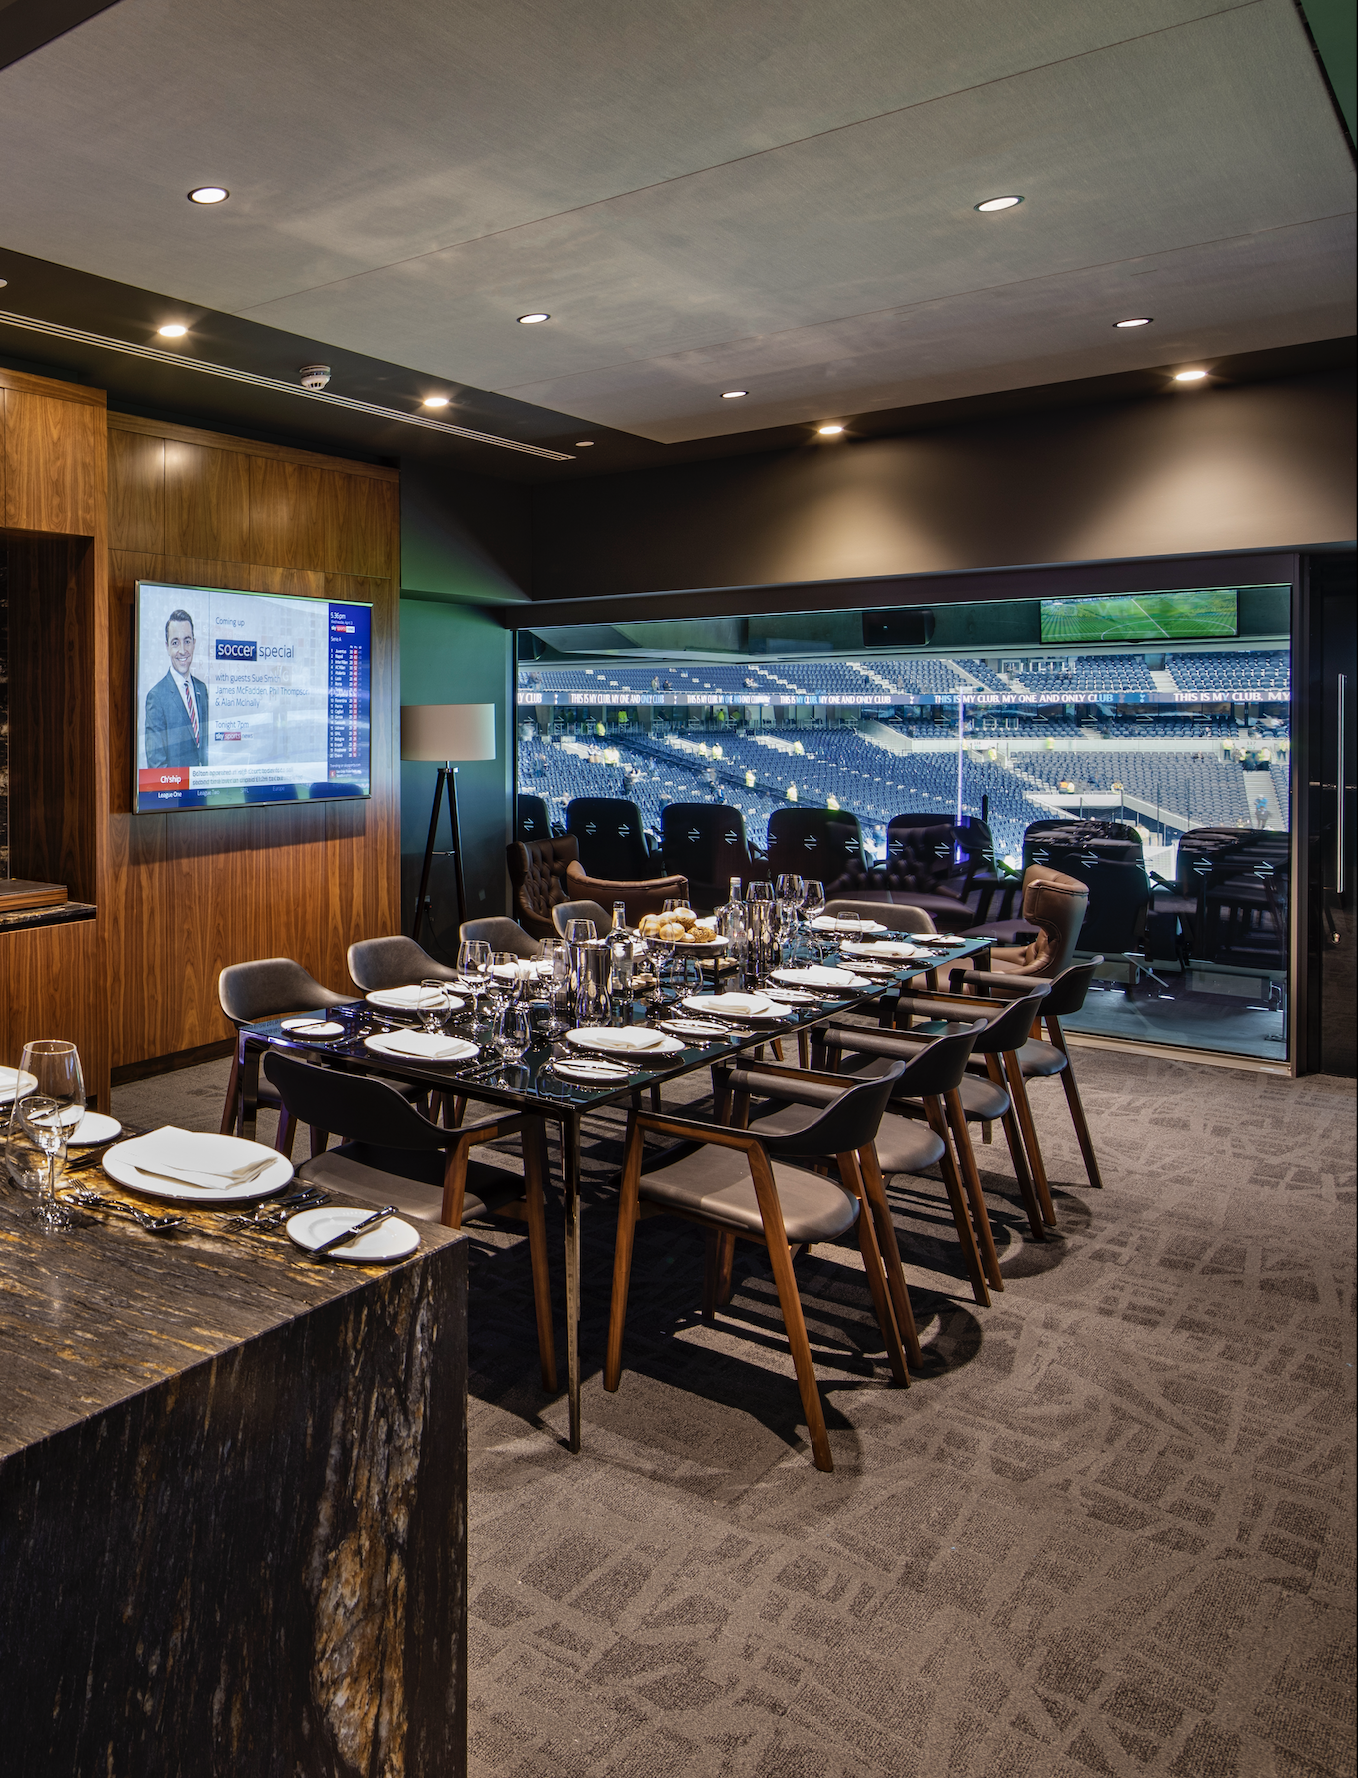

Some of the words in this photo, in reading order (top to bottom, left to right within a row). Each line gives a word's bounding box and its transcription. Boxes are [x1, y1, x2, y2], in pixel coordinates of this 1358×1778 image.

[215, 616, 237, 628] Coming
[238, 620, 246, 628] up
[217, 643, 255, 657] soccer
[259, 645, 294, 660] special
[215, 673, 229, 682] with
[230, 674, 251, 684] guests
[252, 674, 263, 682] Sue
[264, 674, 281, 683] Smith
[215, 686, 235, 694] James
[269, 686, 280, 695] Phil
[525, 693, 542, 704] CLUB
[571, 693, 582, 704] THIS
[584, 693, 588, 704] IS
[589, 693, 597, 704] MY
[611, 694, 619, 704] MY
[620, 694, 629, 704] ONE
[630, 694, 640, 704] AND
[641, 694, 652, 704] ONLY
[653, 694, 664, 704] CLUB
[780, 696, 791, 704] THIS
[796, 696, 804, 704] MY
[818, 696, 828, 704] MY
[828, 696, 840, 704] ONE
[841, 696, 855, 704] AND
[856, 696, 873, 704] ONLY
[874, 696, 892, 704] CLUB
[934, 694, 952, 703] THIS
[953, 694, 961, 703] IS
[962, 694, 976, 703] MY
[1002, 694, 1016, 703] MY
[1018, 694, 1037, 703] ONE
[1039, 694, 1060, 703] AND
[1061, 694, 1085, 703] ONLY
[1088, 694, 1113, 702] CLUB
[1173, 692, 1198, 701] THIS
[1200, 692, 1210, 701] IS
[1212, 692, 1230, 701] MY
[1232, 692, 1264, 701] CLUB.
[1268, 692, 1290, 701] MY
[215, 698, 220, 706] &
[222, 698, 235, 706] Alan
[236, 698, 260, 708] McInally
[215, 721, 236, 730] Tonight
[237, 721, 249, 729] 7pm
[160, 775, 182, 784] Ch'ship
